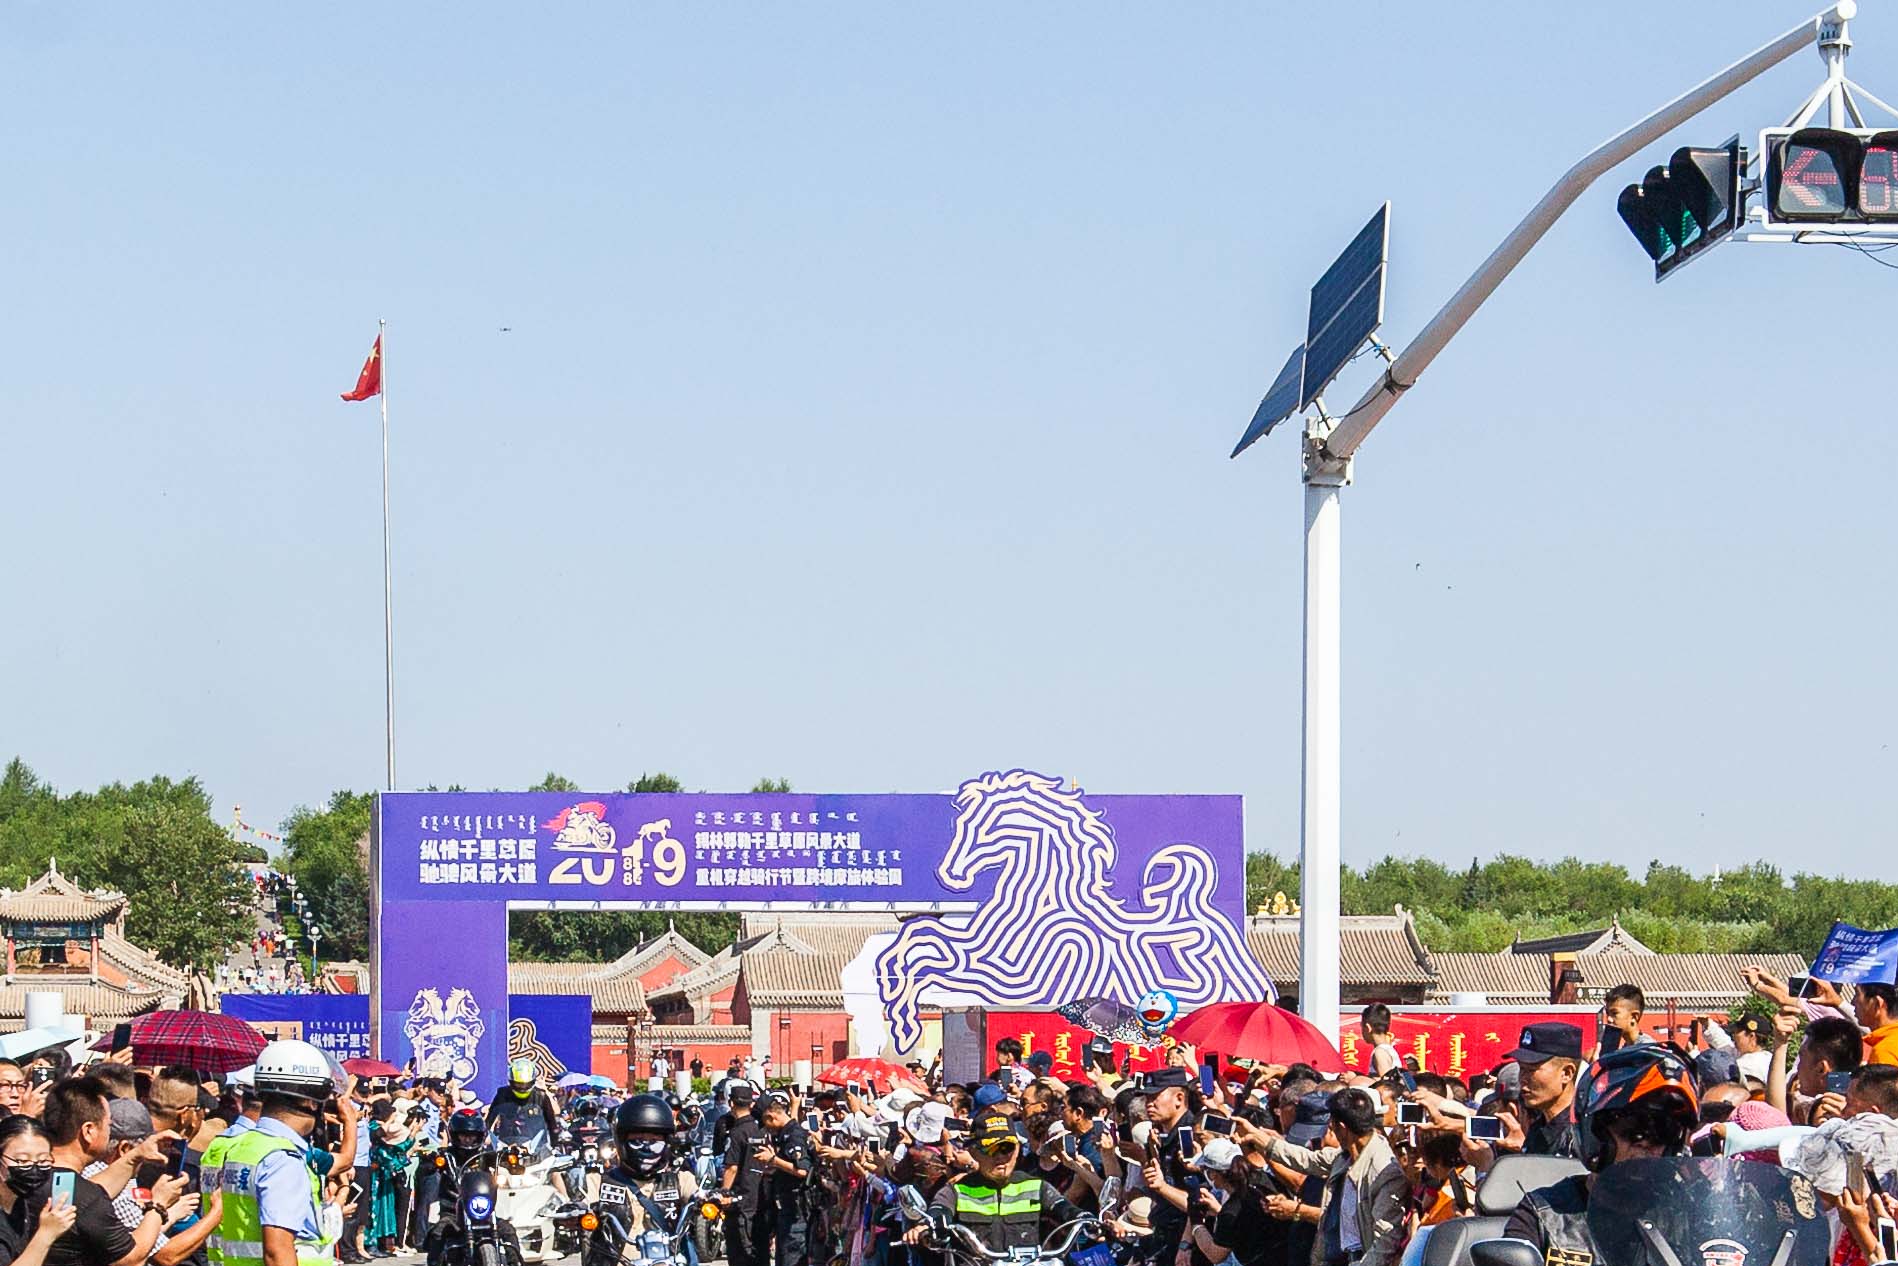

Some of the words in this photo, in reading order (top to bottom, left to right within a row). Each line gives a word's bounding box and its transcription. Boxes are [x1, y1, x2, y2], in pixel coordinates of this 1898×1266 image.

[419, 839, 537, 860] 纵情千里草原
[695, 831, 861, 850] 锡林郭勒千里草原风景大道
[419, 863, 537, 884] 驰骋风景大道
